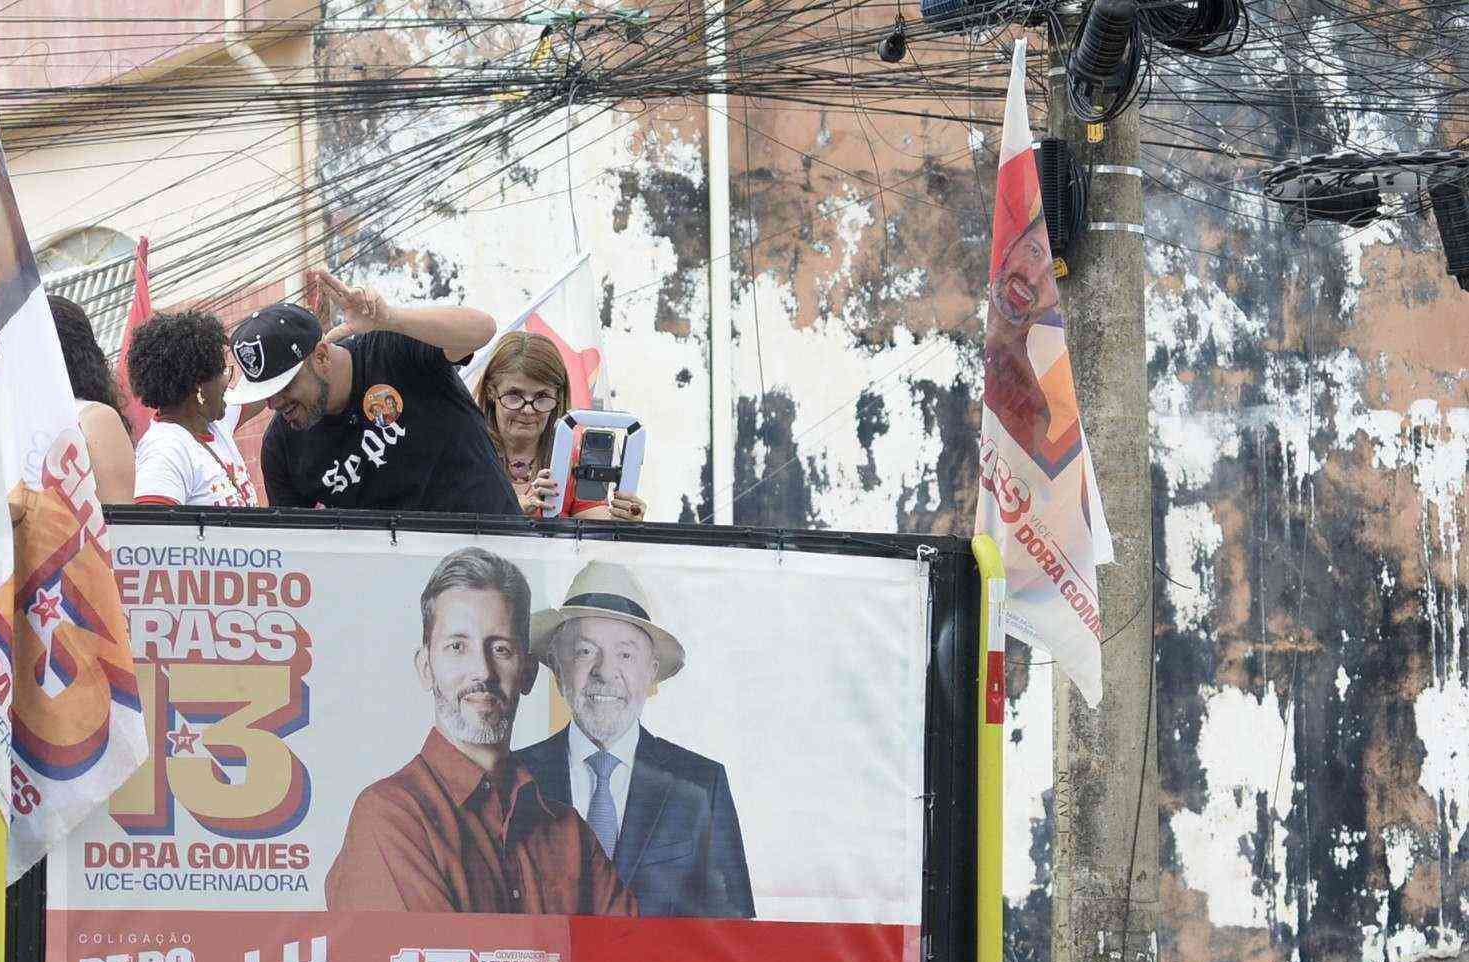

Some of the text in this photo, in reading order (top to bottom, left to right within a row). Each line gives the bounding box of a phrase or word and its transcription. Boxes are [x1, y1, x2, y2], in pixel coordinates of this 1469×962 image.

[116, 546, 282, 568] GOVERNADOR
[1015, 523, 1065, 584] DORA
[84, 842, 310, 871] DORA GOMES
[85, 872, 310, 893] VICE-GOVERNADORA
[78, 931, 193, 947] COLIGAÇÃO
[494, 951, 546, 961] GOVERNADOR
